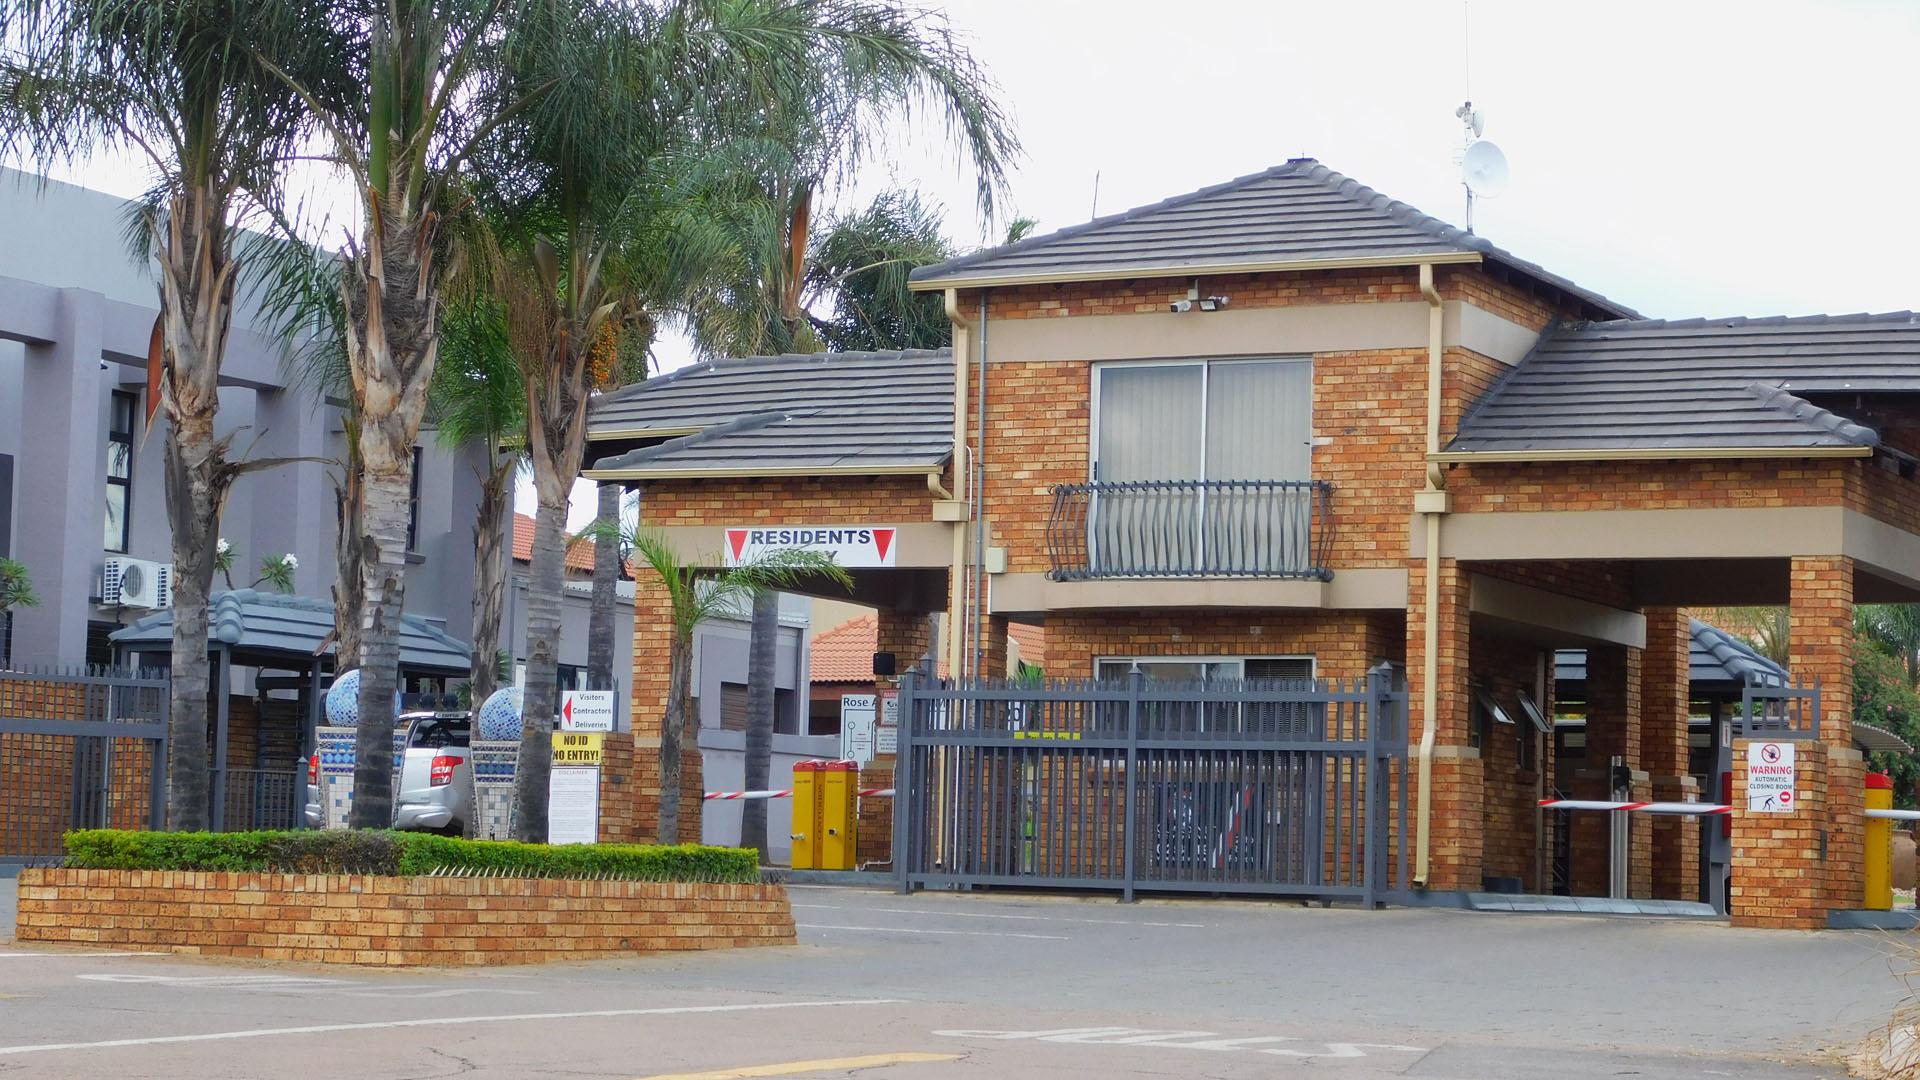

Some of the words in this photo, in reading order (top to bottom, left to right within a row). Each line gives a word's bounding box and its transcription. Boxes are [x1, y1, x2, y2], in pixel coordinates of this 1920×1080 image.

[751, 530, 871, 545] RESIDENTS
[843, 697, 868, 707] Rose
[563, 735, 576, 746] NO
[578, 735, 588, 746] ID
[552, 750, 565, 760] NO
[567, 750, 599, 760] ENTRY!
[1750, 766, 1792, 774] WARNING
[931, 1027, 1431, 1057] STOP
